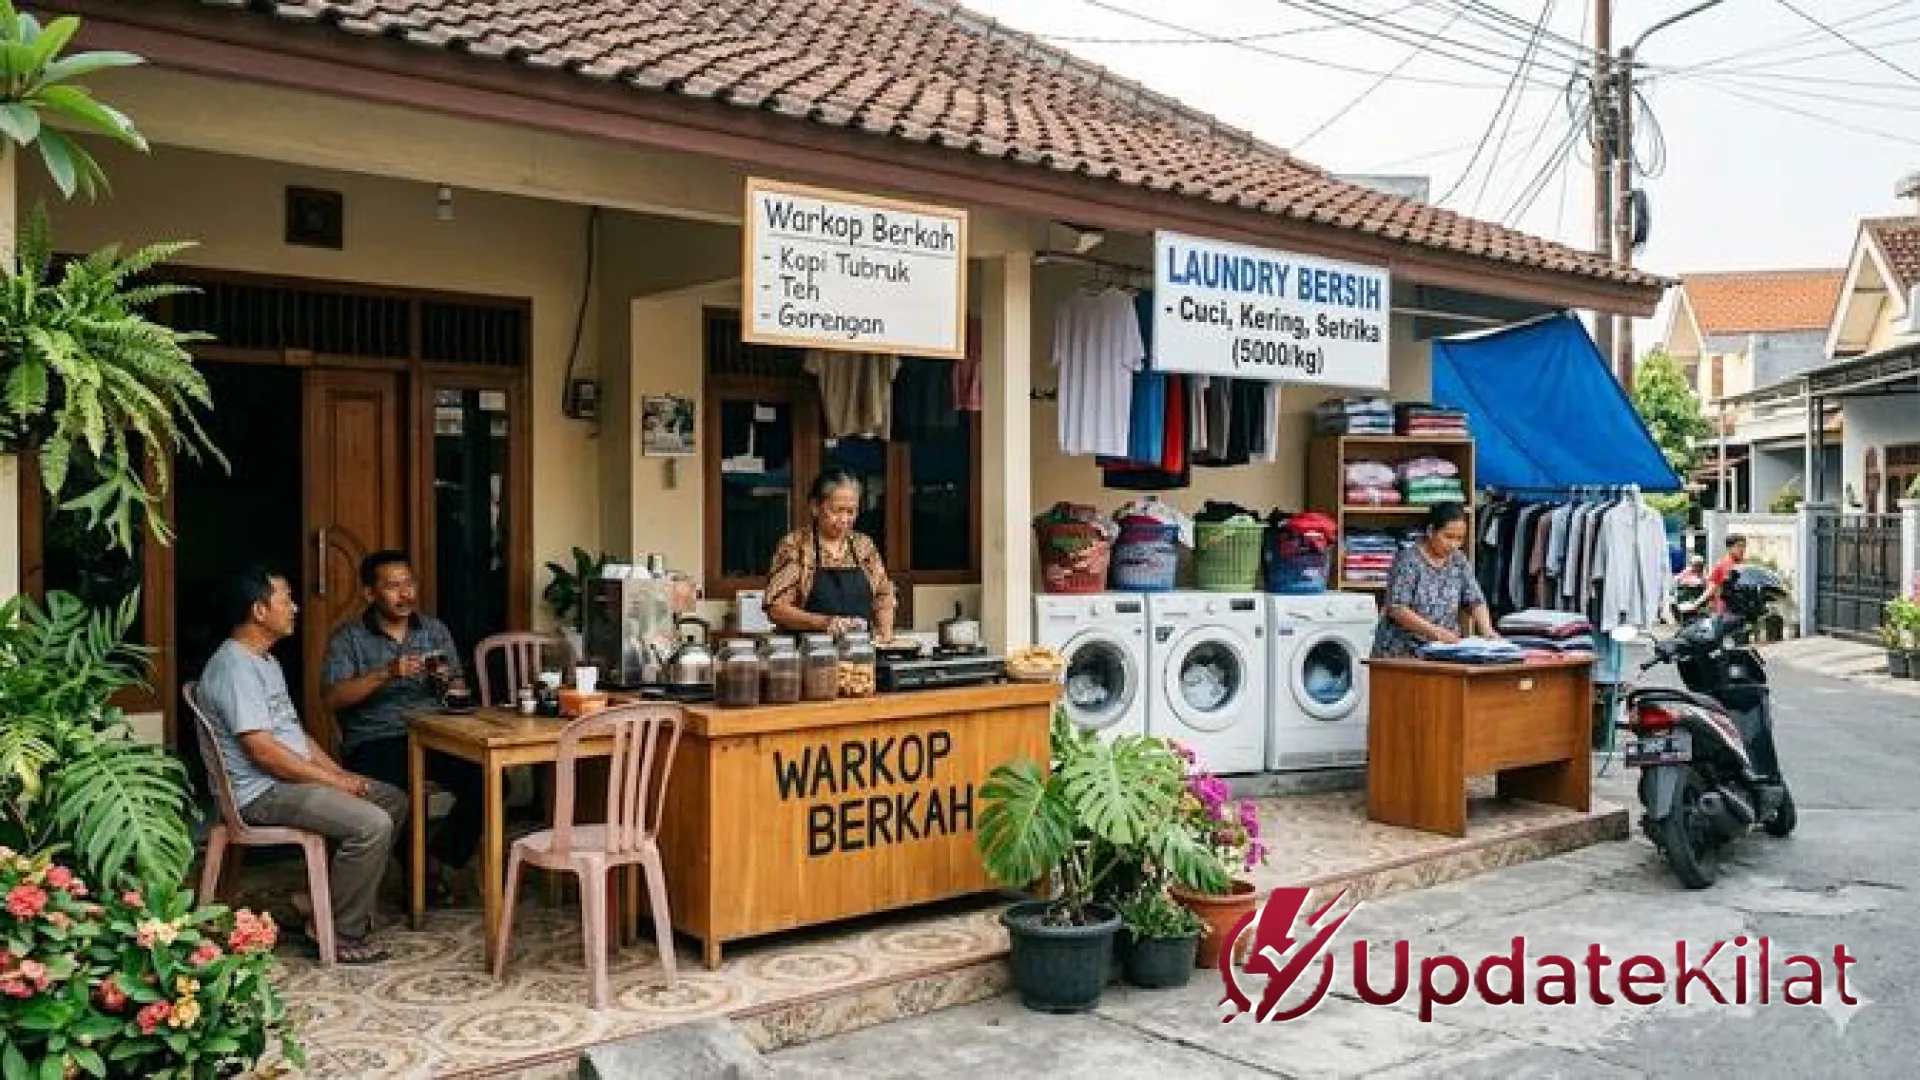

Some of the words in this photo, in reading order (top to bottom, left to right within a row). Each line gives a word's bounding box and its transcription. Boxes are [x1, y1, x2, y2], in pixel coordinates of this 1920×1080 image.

[764, 198, 863, 246] Warkop
[872, 213, 955, 251] Berkah
[779, 274, 820, 302] Teh
[781, 247, 828, 277] Kopi
[836, 252, 911, 283] Tubruk
[1169, 247, 1290, 297] LAUNDRY
[1297, 267, 1381, 311] BERSIH
[778, 302, 885, 339] Gorengan
[1180, 296, 1233, 331] Cuci,
[1240, 304, 1310, 339] Kering,
[1315, 313, 1381, 342] Setrika
[1232, 336, 1325, 374] (5000/kg)
[773, 730, 951, 801] WARKOP
[808, 783, 974, 857] BERKAH
